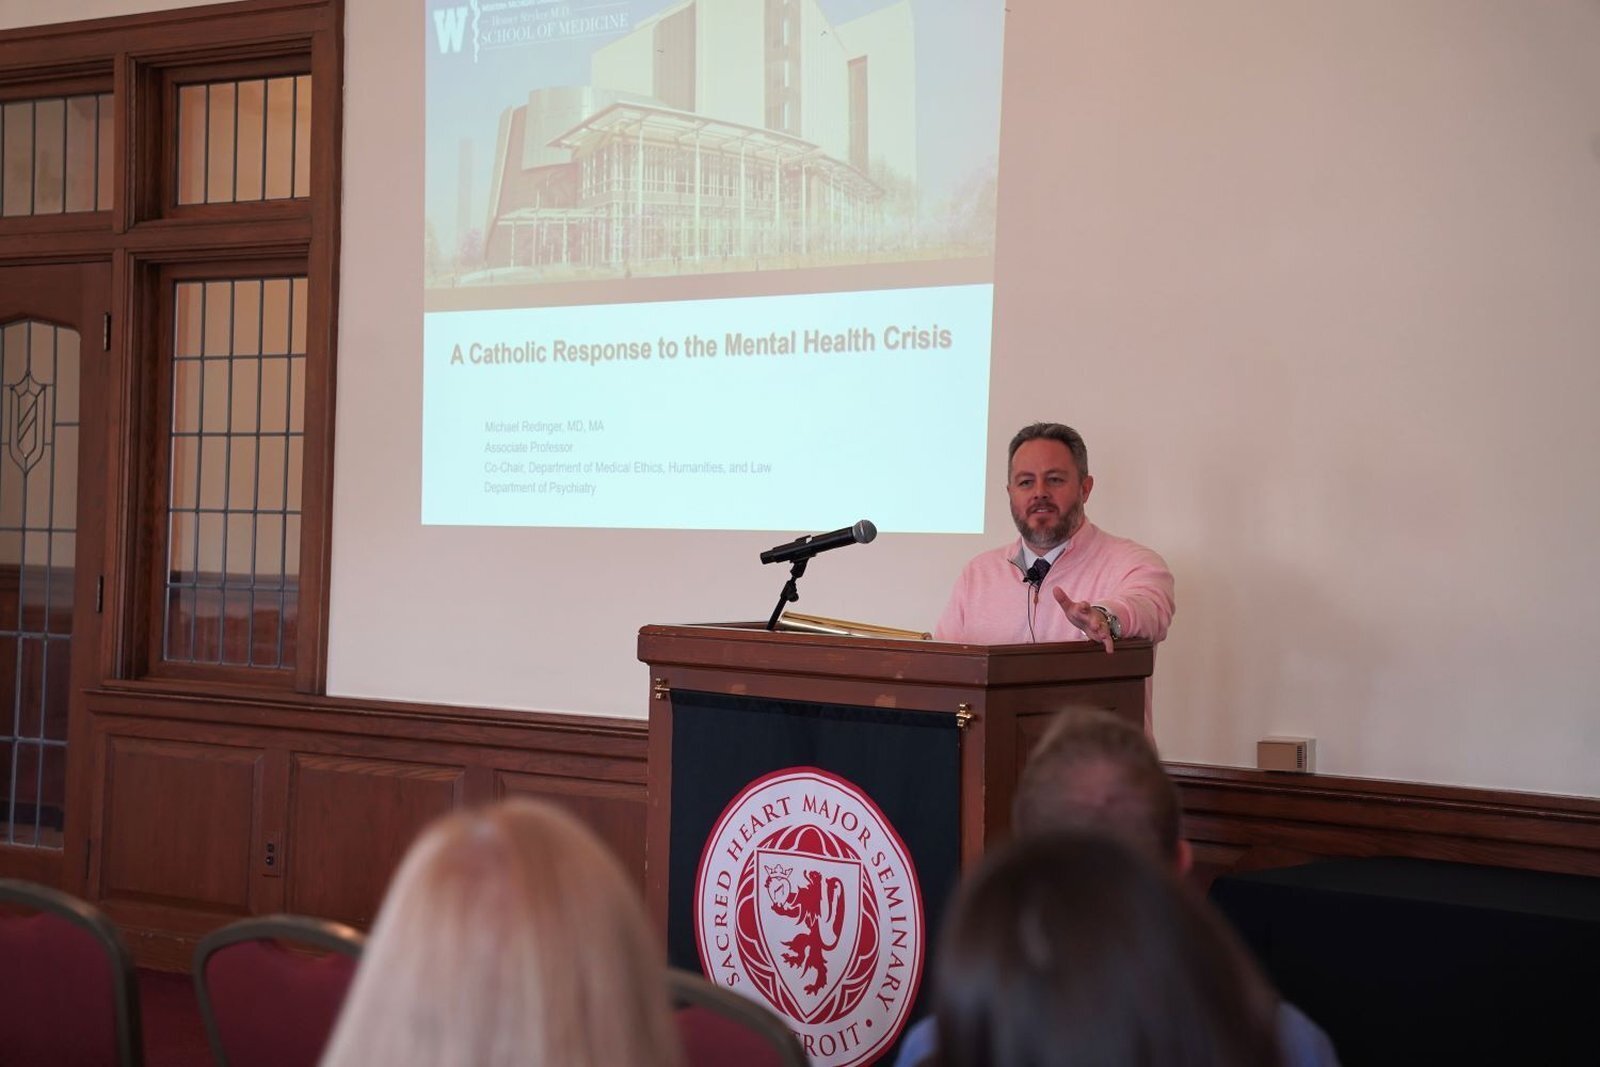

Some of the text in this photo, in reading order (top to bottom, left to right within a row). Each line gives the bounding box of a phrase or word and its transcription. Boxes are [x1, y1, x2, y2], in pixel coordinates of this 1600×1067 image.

[481, 13, 629, 45] SCHOOL OF MEDICINE
[450, 324, 952, 366] A Catholic Response to the Mental Health Crisis
[484, 421, 519, 433] Michael
[567, 420, 586, 433] MD,
[589, 420, 604, 431] MA
[484, 441, 573, 453] Associate Professor
[484, 461, 772, 475] Co-Chair, Department of Medical Ethics, Humanities, and Law
[484, 481, 597, 496] Department of Psychiatry
[713, 793, 908, 1012] SACRED HEART MAJOR SEMINARY
[791, 1021, 860, 1057] ROIT
